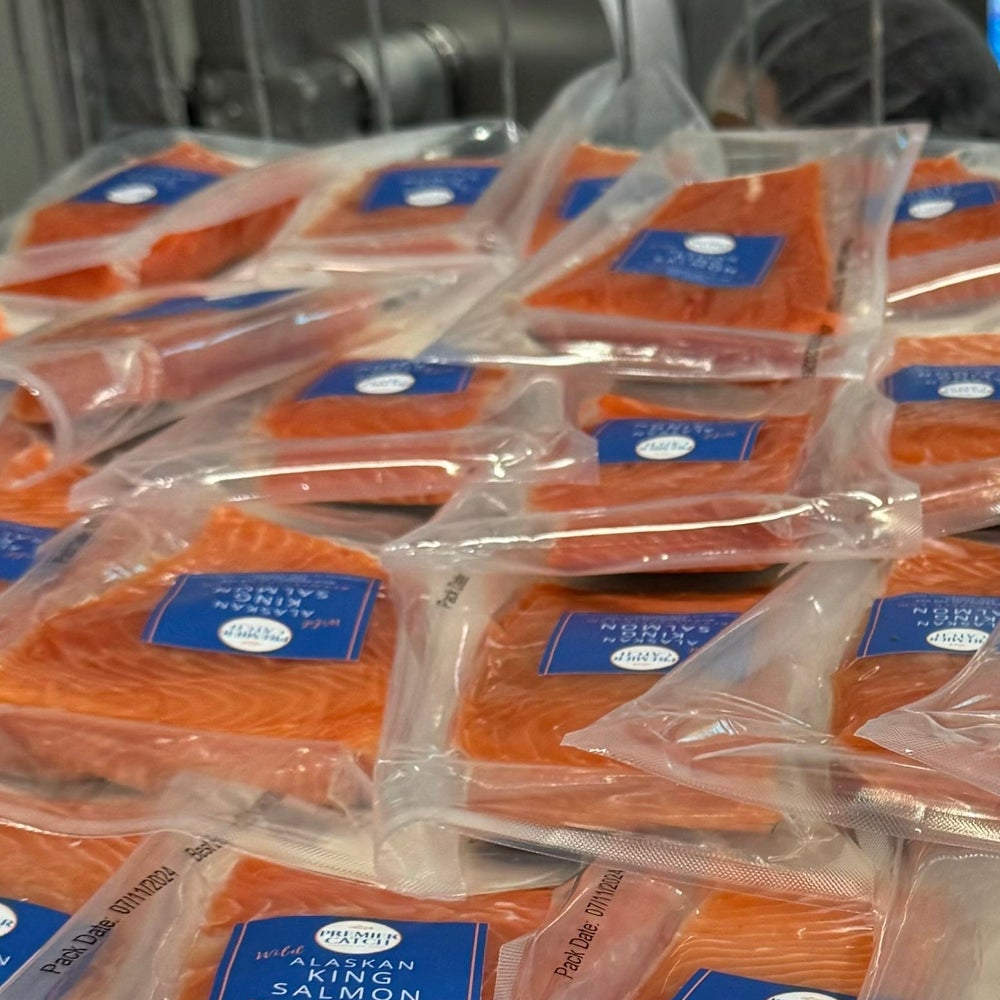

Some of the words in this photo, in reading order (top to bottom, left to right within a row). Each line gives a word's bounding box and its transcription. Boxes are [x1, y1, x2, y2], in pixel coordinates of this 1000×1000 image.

[585, 870, 624, 917] 07/11/2024
[40, 943, 87, 975] Pack
[73, 917, 119, 946] Date:
[109, 866, 179, 914] 07/11/2024
[320, 930, 400, 940] PREMIER
[324, 937, 390, 946] CATCH
[569, 921, 599, 949] Date:
[256, 945, 303, 960] Wild
[290, 958, 414, 970] ALASKAN
[554, 950, 585, 979] Pack
[308, 970, 392, 984] KING
